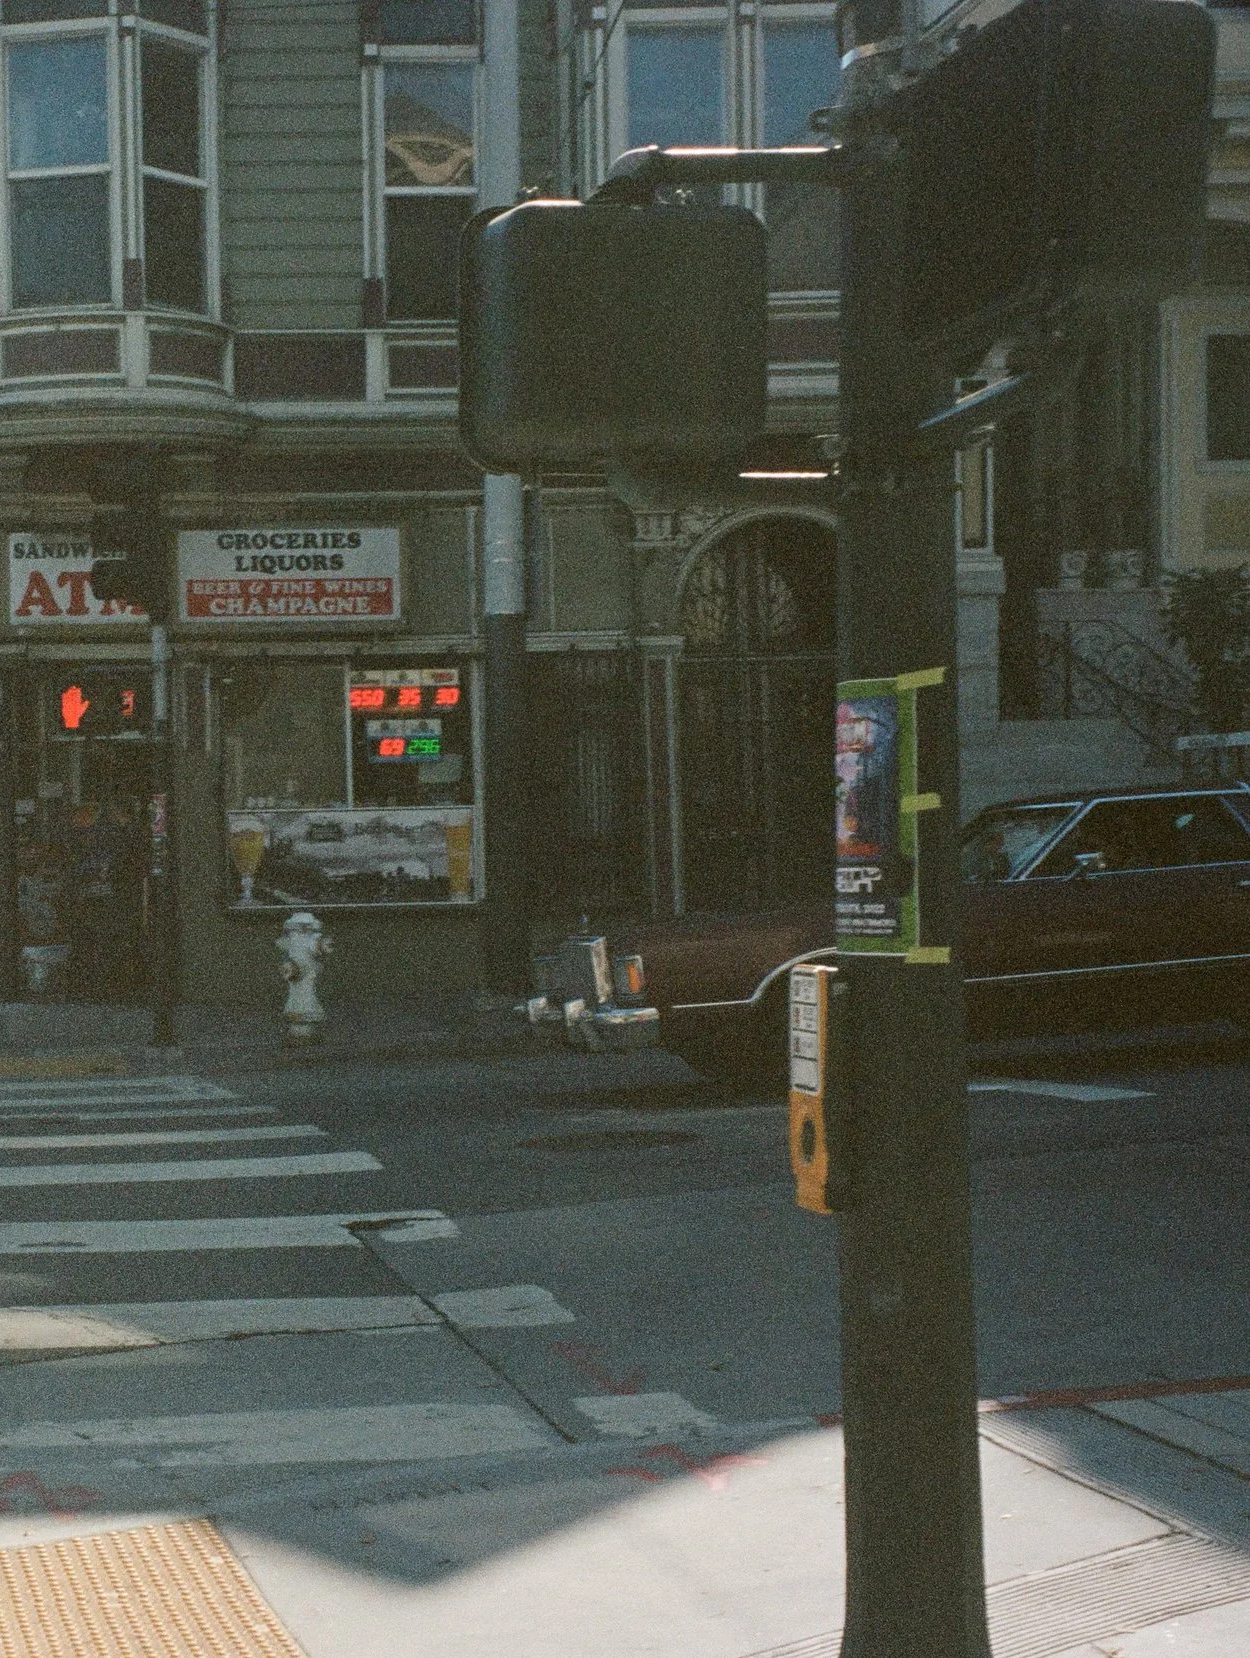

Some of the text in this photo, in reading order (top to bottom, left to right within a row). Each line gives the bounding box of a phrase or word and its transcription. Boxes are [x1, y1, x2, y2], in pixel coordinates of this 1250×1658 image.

[216, 531, 362, 550] GROCERIES
[234, 554, 344, 573] LIQUORS
[193, 580, 388, 595] BEER & FINE WINES
[209, 596, 371, 615] CHAMPAGNE
